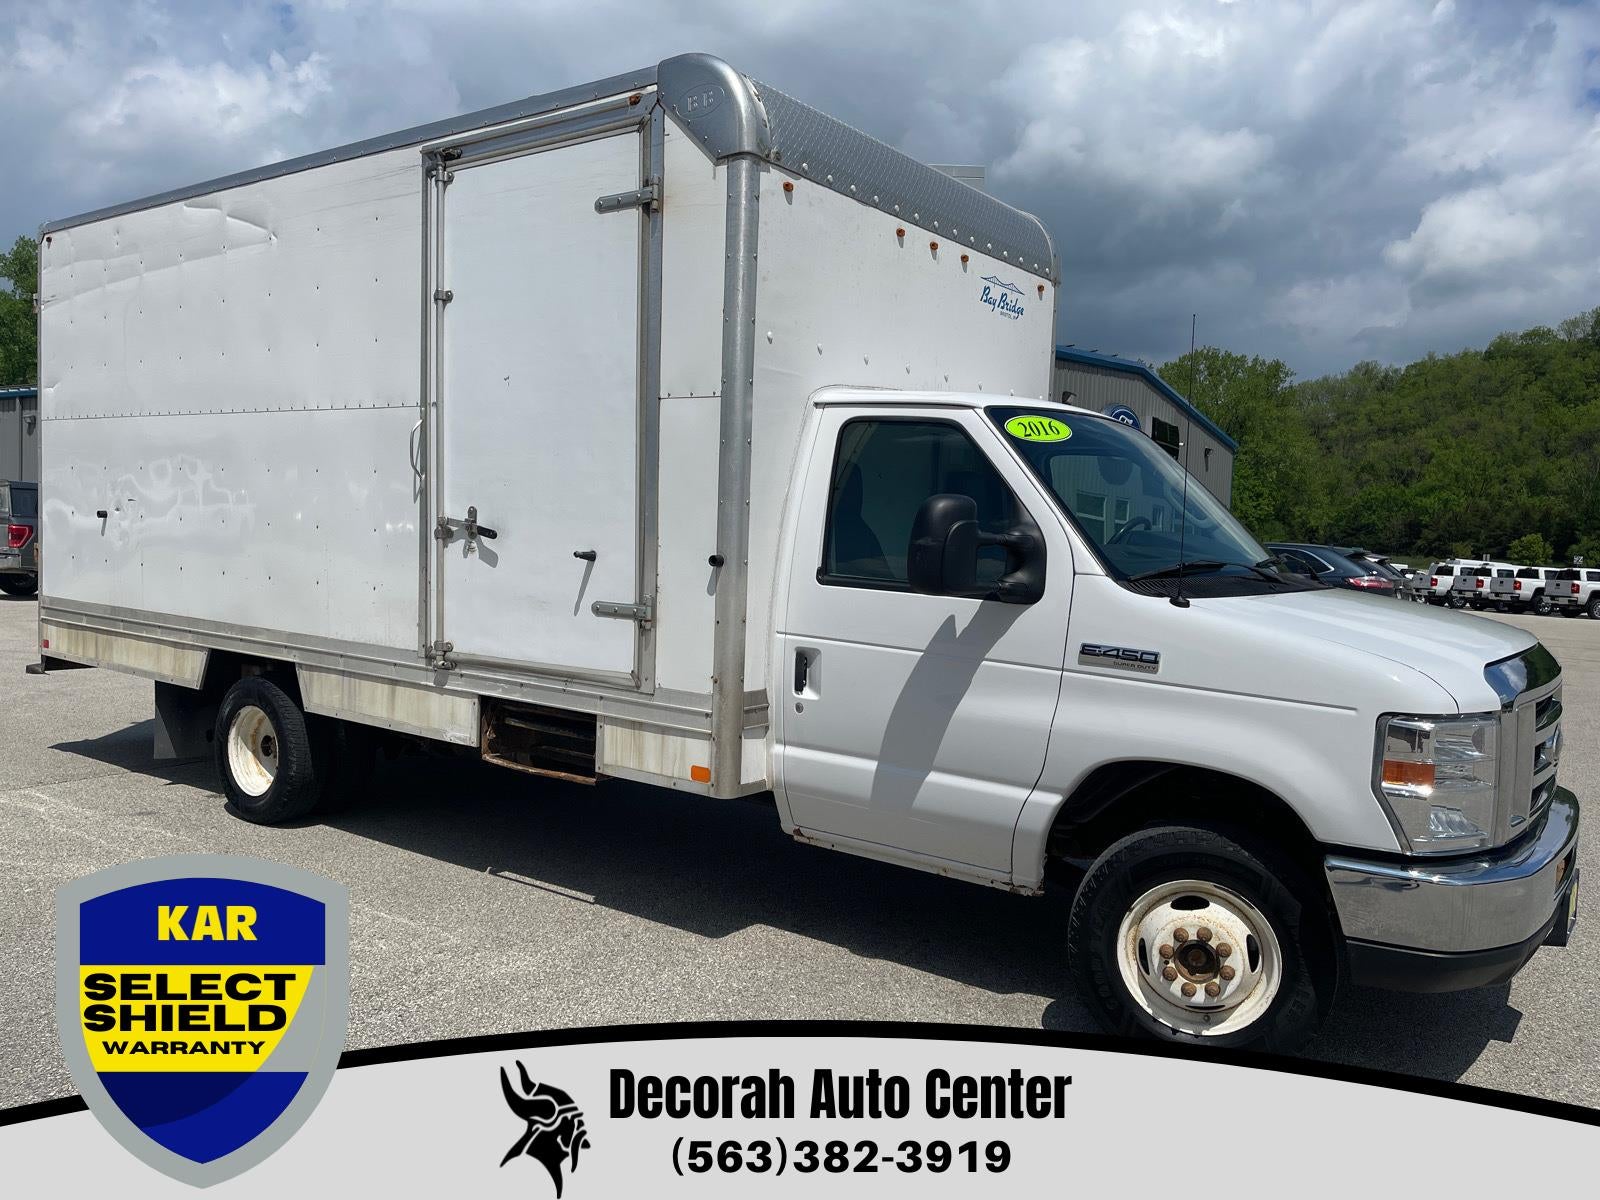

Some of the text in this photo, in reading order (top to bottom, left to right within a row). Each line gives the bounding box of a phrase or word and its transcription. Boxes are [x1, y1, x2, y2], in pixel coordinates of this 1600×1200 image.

[979, 285, 1025, 320] Bay Bridge
[1017, 420, 1061, 438] 2016
[1080, 643, 1160, 665] E-450
